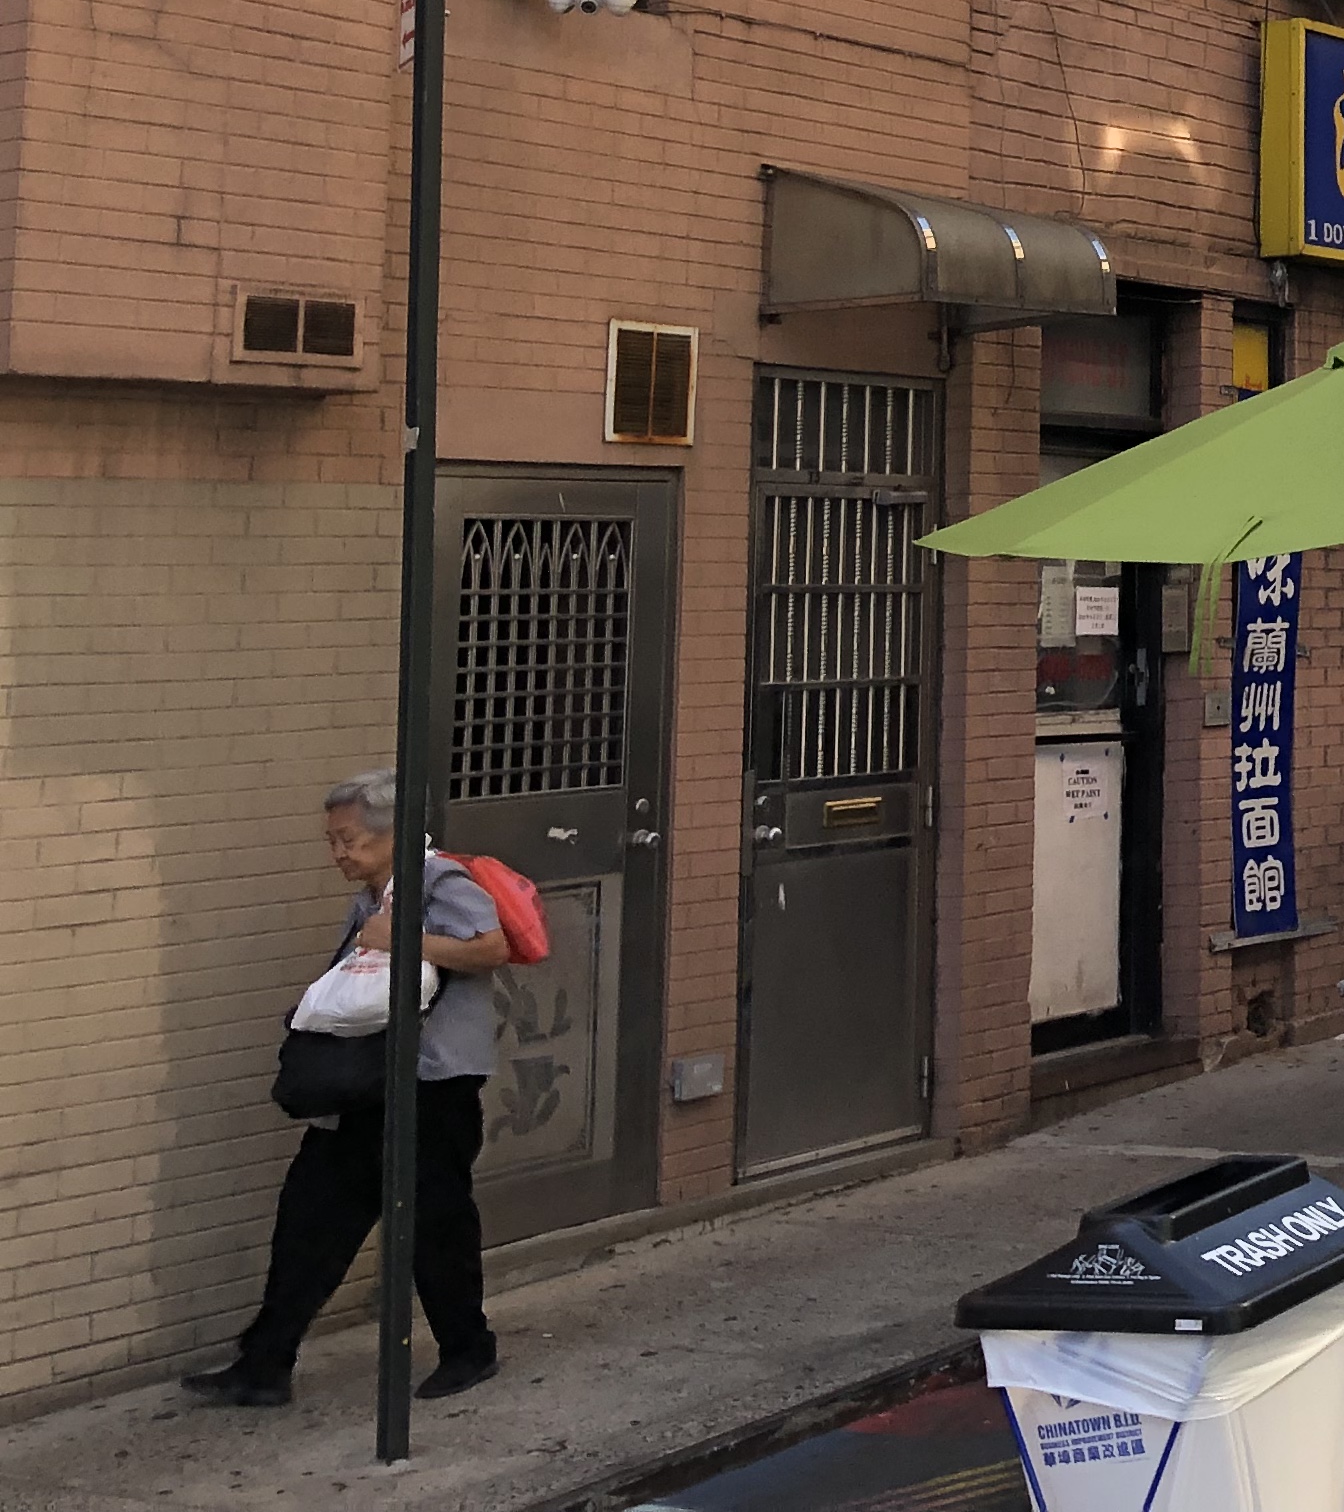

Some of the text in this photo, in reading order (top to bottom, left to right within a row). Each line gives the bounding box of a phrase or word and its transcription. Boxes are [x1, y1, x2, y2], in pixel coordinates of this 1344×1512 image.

[1307, 220, 1318, 240] 1
[1201, 1224, 1304, 1276] TRASH
[1037, 1414, 1112, 1440] CHINATOWN
